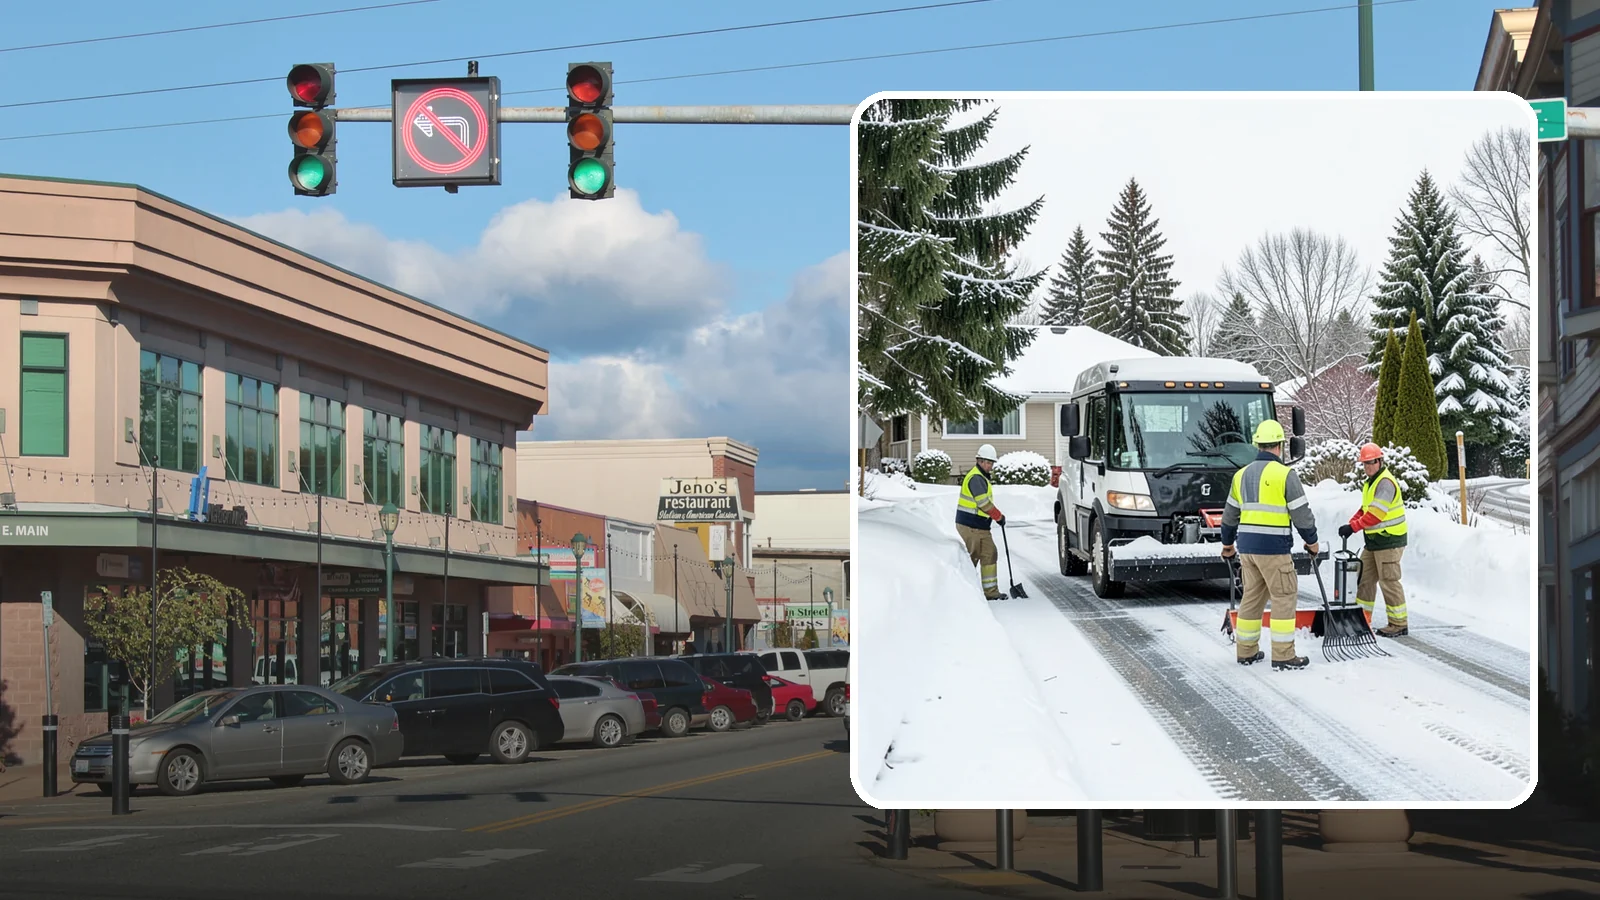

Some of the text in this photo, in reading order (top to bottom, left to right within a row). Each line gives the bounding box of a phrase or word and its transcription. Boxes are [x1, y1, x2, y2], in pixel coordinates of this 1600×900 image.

[669, 481, 728, 494] Jeno's
[665, 497, 731, 509] restaurant
[658, 510, 681, 520] Italian
[686, 510, 714, 519] American
[715, 510, 738, 519] Cuisine
[2, 525, 49, 536] E. MAIN
[797, 607, 828, 616] Street
